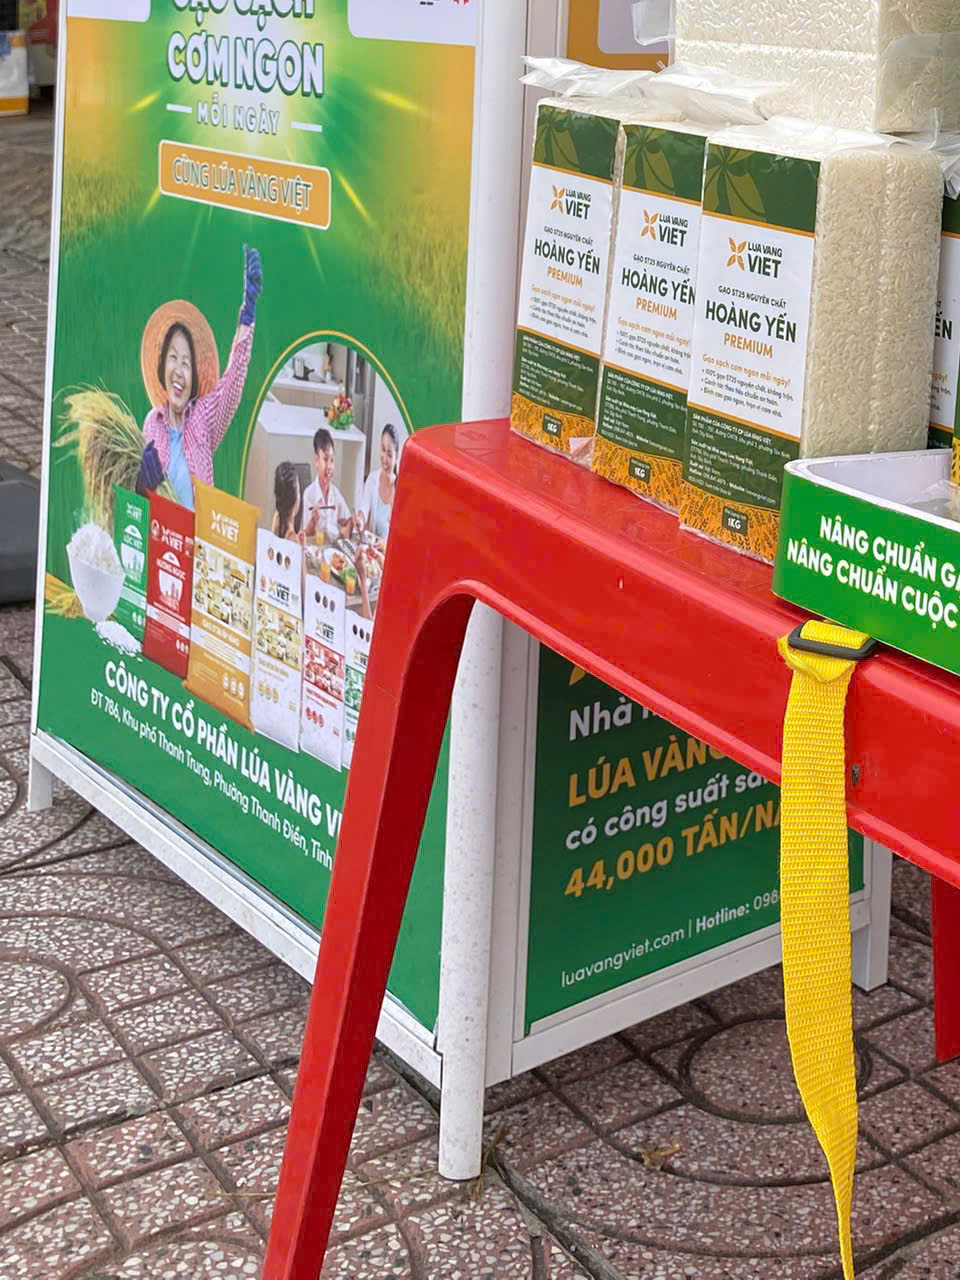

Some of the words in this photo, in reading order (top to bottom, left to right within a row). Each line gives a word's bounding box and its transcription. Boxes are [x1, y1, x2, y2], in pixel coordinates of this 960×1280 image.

[167, 30, 230, 87] CƠM
[234, 36, 324, 98] NGON
[196, 92, 228, 128] MỖI
[233, 102, 280, 136] NGÀY
[172, 151, 209, 189] CÙNG
[212, 161, 238, 194] LÚA
[239, 164, 278, 200] VÀNG
[280, 177, 313, 213] VIỆT
[534, 238, 575, 266] HOÀNG
[577, 249, 600, 275] YẾN
[547, 266, 583, 288] PREMIUM
[748, 253, 781, 278] VIET
[621, 267, 668, 297] HOÀNG
[636, 297, 677, 320] PREMIUM
[706, 300, 761, 332] HOÀNG
[765, 312, 796, 343] YẾN
[724, 332, 773, 358] PREMIUM
[727, 517, 741, 530] 1KG
[820, 515, 869, 554] NÂNG
[872, 541, 937, 582] CHUẨN
[787, 537, 833, 576] NÂNG
[836, 559, 898, 605] CHUẨN
[901, 585, 958, 629] CUỘC
[569, 697, 632, 741] Nhà
[104, 696, 121, 722] 786,
[122, 708, 139, 732] Khu
[140, 720, 157, 743] phố
[158, 731, 184, 763] Thanh
[186, 749, 212, 787] Trung,
[214, 770, 249, 813] Phường
[251, 795, 281, 832] Thanh
[105, 660, 149, 708] CÔNG
[150, 687, 170, 720] TY
[171, 700, 195, 738] CỔ
[197, 719, 238, 769] PHẦN
[241, 746, 271, 793] LÚA
[274, 764, 321, 826] VÀNG
[568, 756, 636, 807] LÚA
[566, 817, 597, 850] có
[605, 800, 668, 839] công
[675, 772, 729, 814] suất
[564, 837, 674, 898] 44,000
[682, 800, 781, 857] TẤN/N
[561, 927, 685, 988] luavangviet.com
[695, 903, 750, 934] Hotline:
